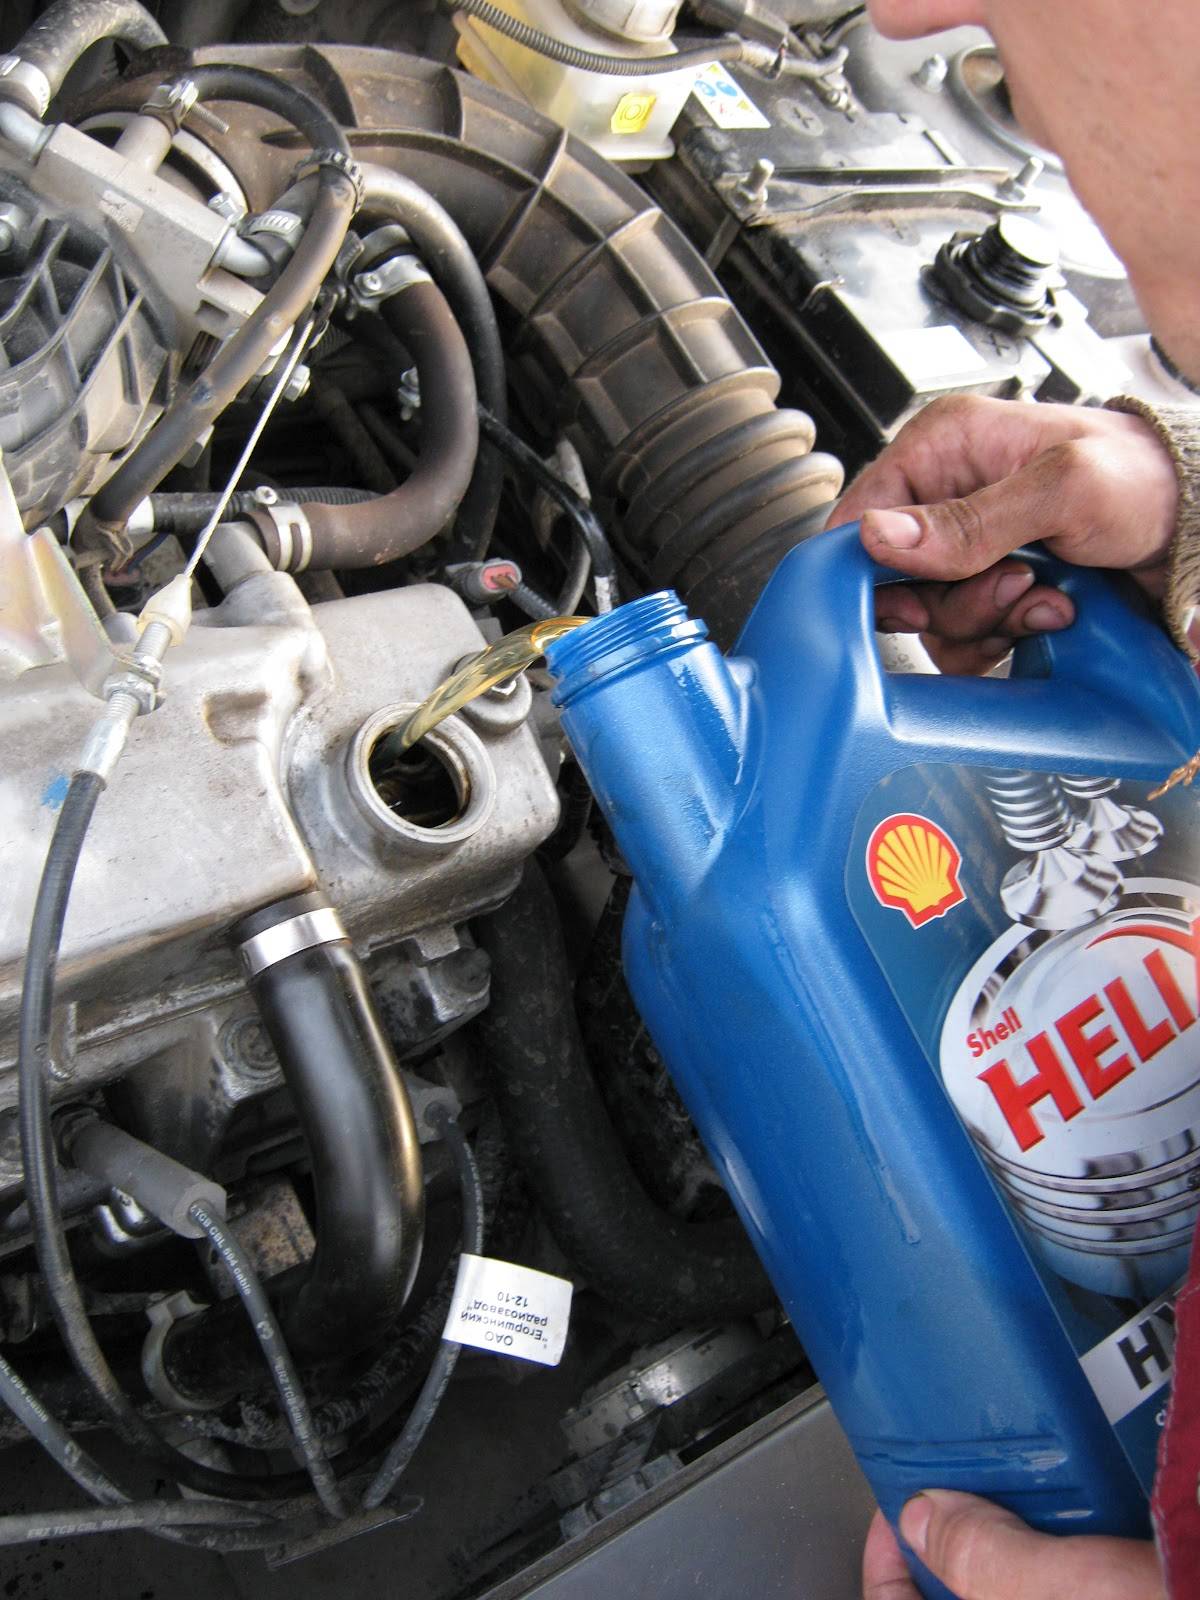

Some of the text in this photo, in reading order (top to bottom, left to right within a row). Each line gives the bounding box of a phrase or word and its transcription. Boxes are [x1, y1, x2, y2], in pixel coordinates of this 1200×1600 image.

[966, 1006, 1023, 1058] Shell
[976, 948, 1197, 1153] HELI
[497, 1291, 528, 1308] 12-10
[484, 1330, 514, 1346] ОАО
